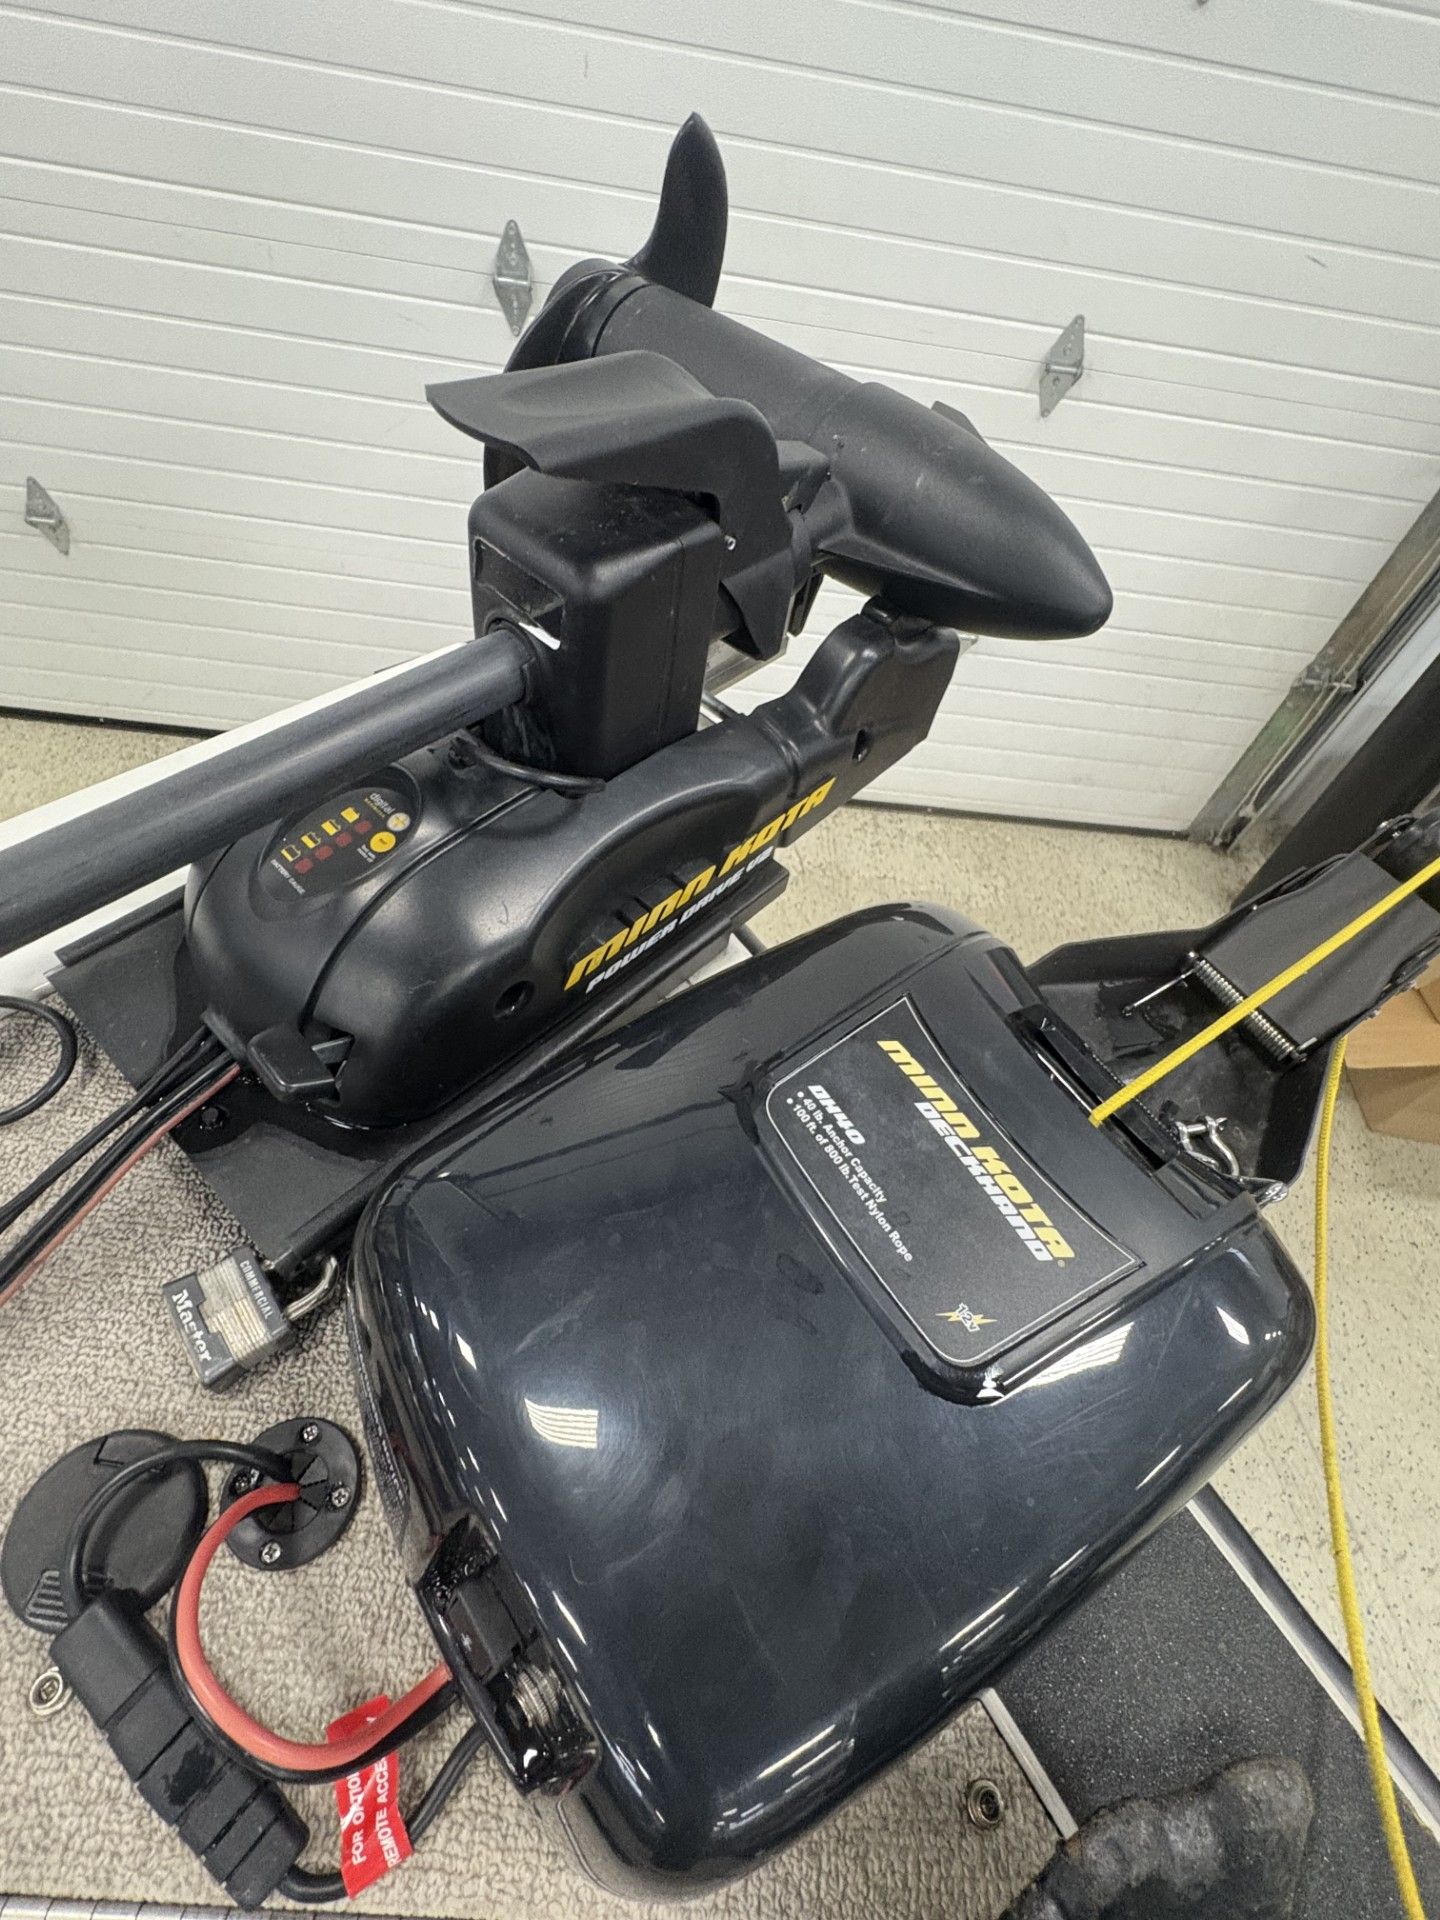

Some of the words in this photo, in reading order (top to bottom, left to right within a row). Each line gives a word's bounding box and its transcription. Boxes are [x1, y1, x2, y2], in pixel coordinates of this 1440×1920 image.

[564, 865, 717, 991] MINN
[718, 776, 837, 877] KOTA
[585, 918, 678, 994] POWER
[679, 867, 746, 925] DRIVE
[803, 1098, 817, 1111] 40
[812, 1110, 823, 1124] lb.
[822, 1124, 853, 1157] Anchor
[850, 1157, 888, 1203] Capacity
[808, 1085, 866, 1145] DH40
[877, 1040, 980, 1138] MINN
[969, 1146, 1075, 1258] KOTA
[793, 1104, 811, 1123] 100
[806, 1121, 817, 1135] ft.
[815, 1134, 829, 1146] of
[824, 1144, 843, 1165] 800
[848, 1174, 869, 1201] Test
[865, 1199, 892, 1232] Nylon
[889, 1230, 913, 1262] Rope
[914, 1102, 1053, 1261] DECKHAND
[171, 1289, 212, 1362] Master
[239, 1260, 275, 1320] COMMERCIAL
[347, 1771, 365, 1826] OPTIO
[374, 1757, 390, 1804] ACCE
[351, 1828, 367, 1866] FOR
[375, 1806, 402, 1868] REMOTE
